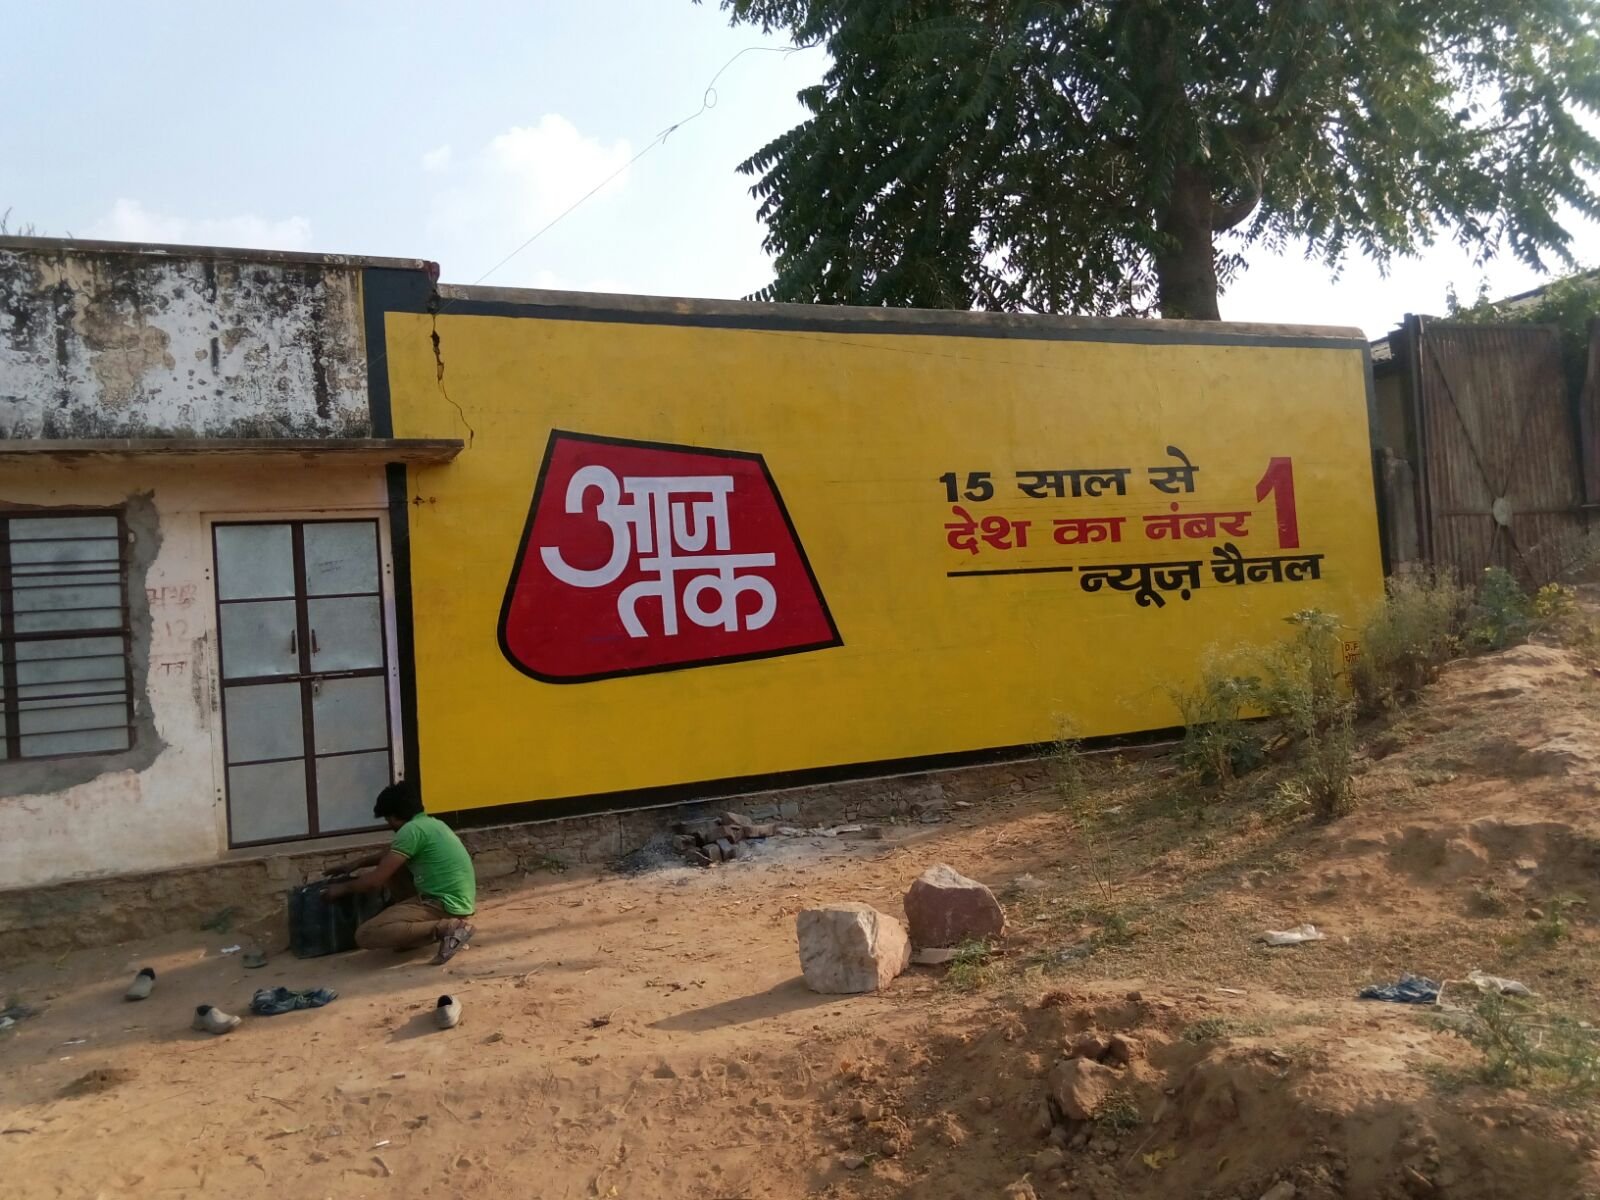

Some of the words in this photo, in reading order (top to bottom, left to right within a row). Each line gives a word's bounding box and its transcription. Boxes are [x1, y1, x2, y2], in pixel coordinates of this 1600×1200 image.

[939, 472, 994, 502] 15
[1016, 468, 1131, 498] साल
[1148, 446, 1199, 493] से
[944, 506, 1031, 555] देश
[1053, 517, 1126, 545] का
[1143, 502, 1252, 540] नंबर
[1256, 457, 1300, 549] 1
[540, 465, 734, 588] आज
[617, 552, 777, 638] तक
[1079, 561, 1202, 608] न्यूज़
[1211, 542, 1324, 585] चैनल
